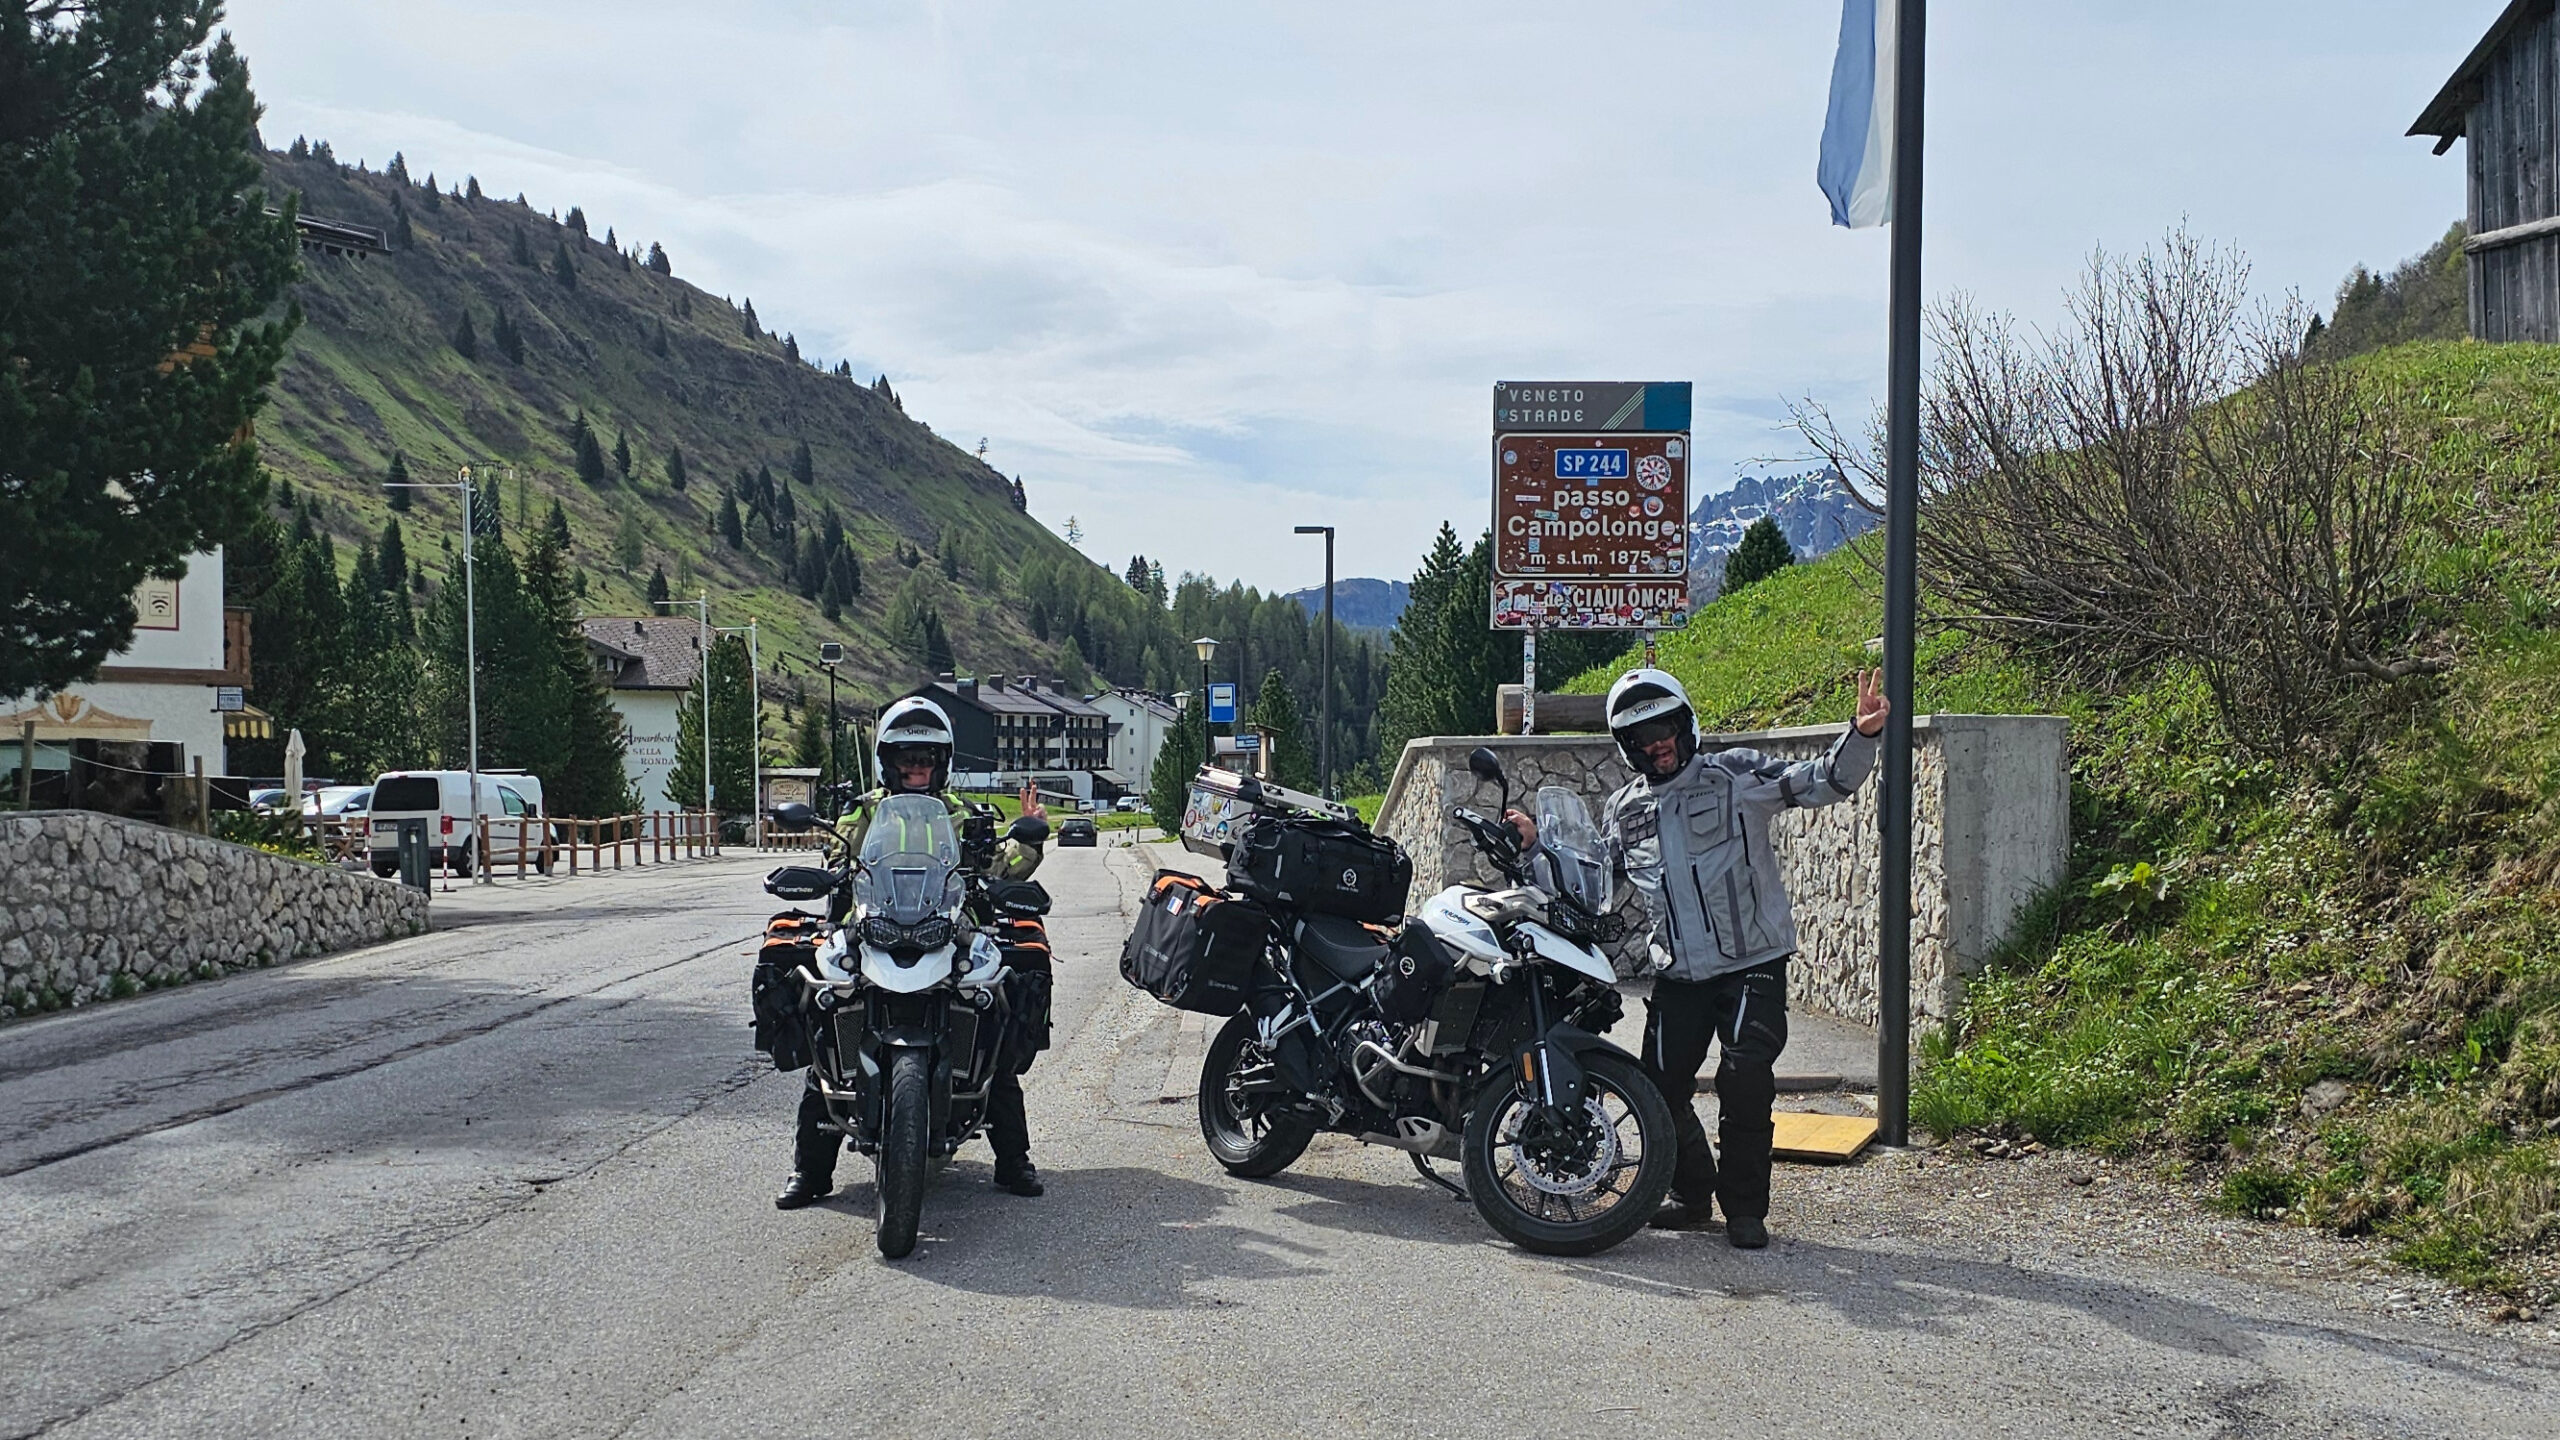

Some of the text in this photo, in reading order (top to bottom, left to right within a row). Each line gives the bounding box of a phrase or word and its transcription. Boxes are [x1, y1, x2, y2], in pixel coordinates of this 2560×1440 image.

[1509, 389, 1584, 402] VENETO
[1508, 409, 1584, 422] STRADE
[1563, 455, 1620, 472] SP 244
[1553, 490, 1630, 511] passo
[1507, 515, 1675, 541] Campolong
[1608, 550, 1651, 565] 1875
